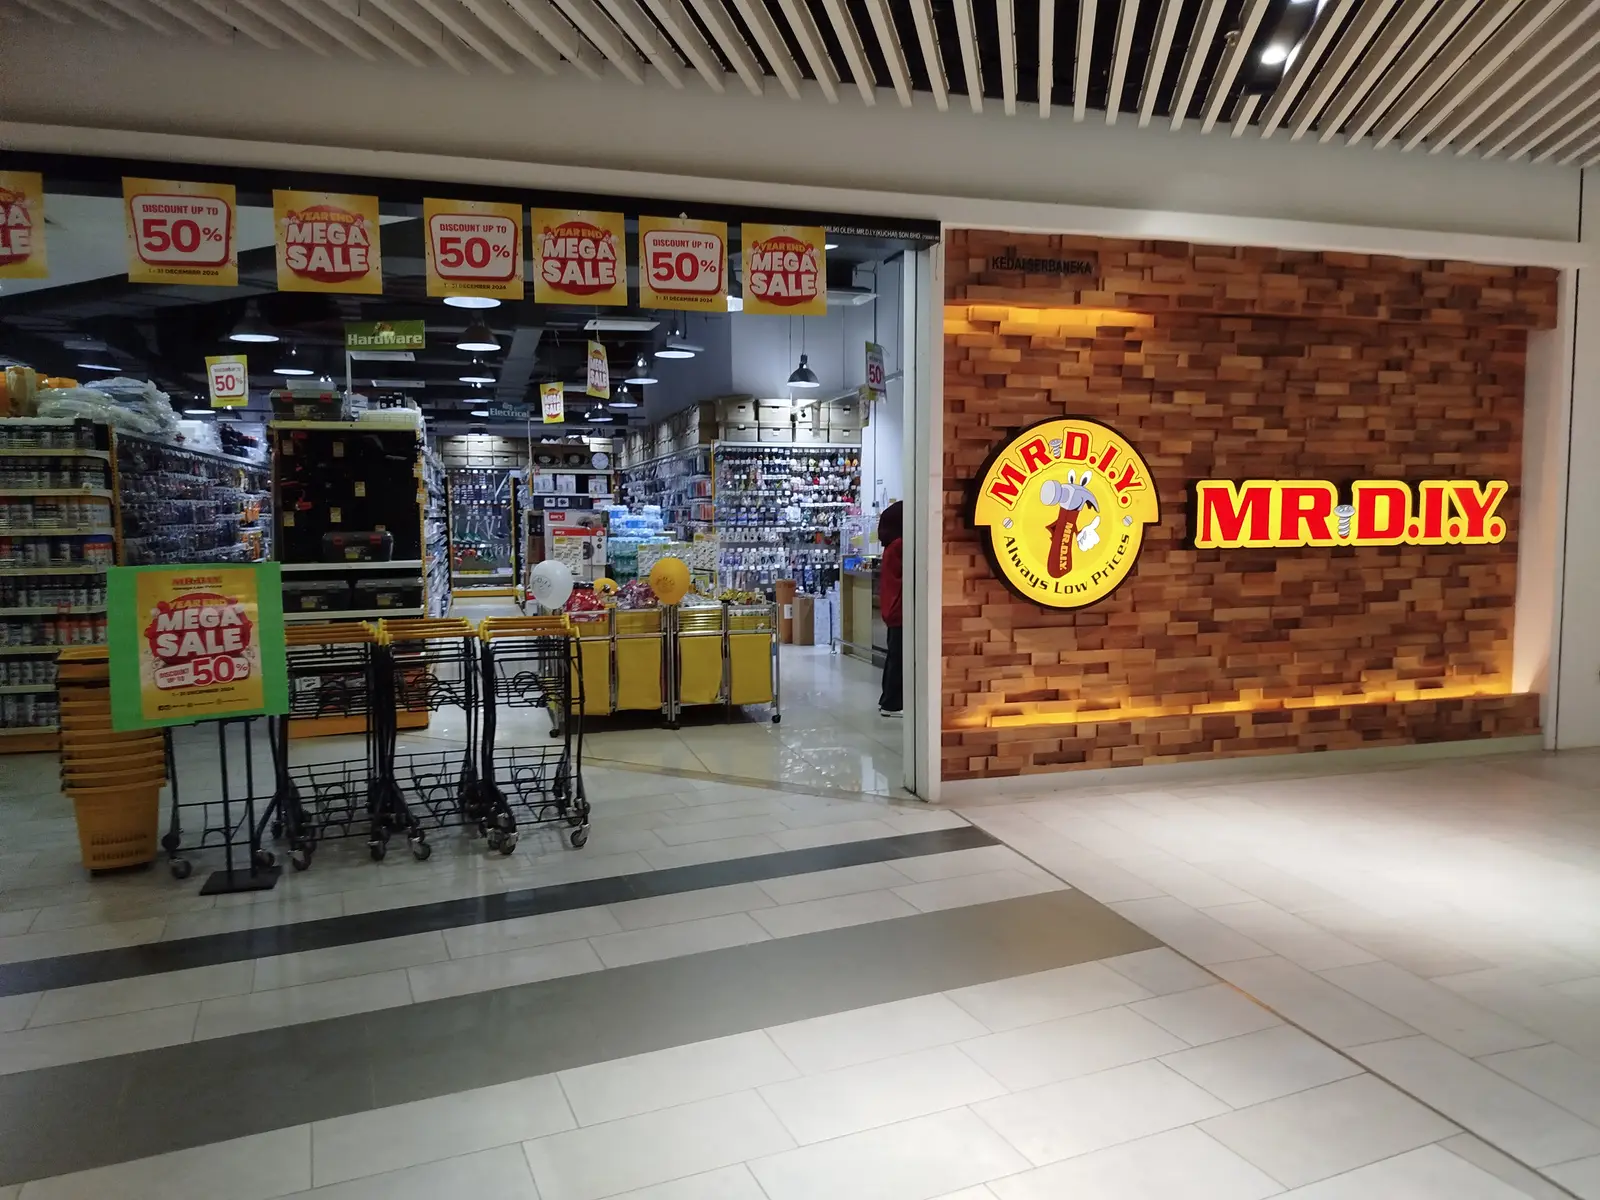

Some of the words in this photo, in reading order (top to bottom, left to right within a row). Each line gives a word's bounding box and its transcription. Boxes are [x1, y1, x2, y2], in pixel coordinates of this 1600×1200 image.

[142, 204, 188, 213] DISCOUNT
[191, 206, 203, 214] UP
[206, 207, 218, 215] TO
[299, 212, 329, 221] YEAR
[330, 213, 354, 222] END
[142, 219, 222, 253] 50%
[286, 222, 369, 246] MEGA
[440, 223, 480, 232] DISCOUNT
[483, 224, 494, 232] UP
[496, 225, 506, 234] TO
[553, 228, 580, 236] YEAR
[582, 229, 603, 239] END
[440, 237, 510, 268] 50%
[543, 237, 615, 260] MEGA
[652, 239, 689, 248] DISCOUNT
[692, 240, 702, 249] UP
[704, 241, 714, 249] TO
[761, 242, 785, 251] YEAR
[786, 243, 806, 253] END
[287, 245, 369, 273] SALE
[652, 252, 716, 282] 50%
[751, 252, 817, 273] MEGA
[543, 259, 616, 286] SALE
[751, 272, 817, 297] SALE
[347, 333, 422, 345] Hardware
[590, 369, 607, 383] SALE
[489, 407, 530, 418] Electrical
[545, 403, 561, 414] SALE
[1003, 535, 1048, 590] Always
[1054, 581, 1088, 594] Low
[1091, 533, 1130, 585] Prices
[170, 600, 200, 609] YEAR
[157, 608, 243, 632] MEGA
[157, 628, 243, 657] SALE
[193, 655, 248, 685] 50%
